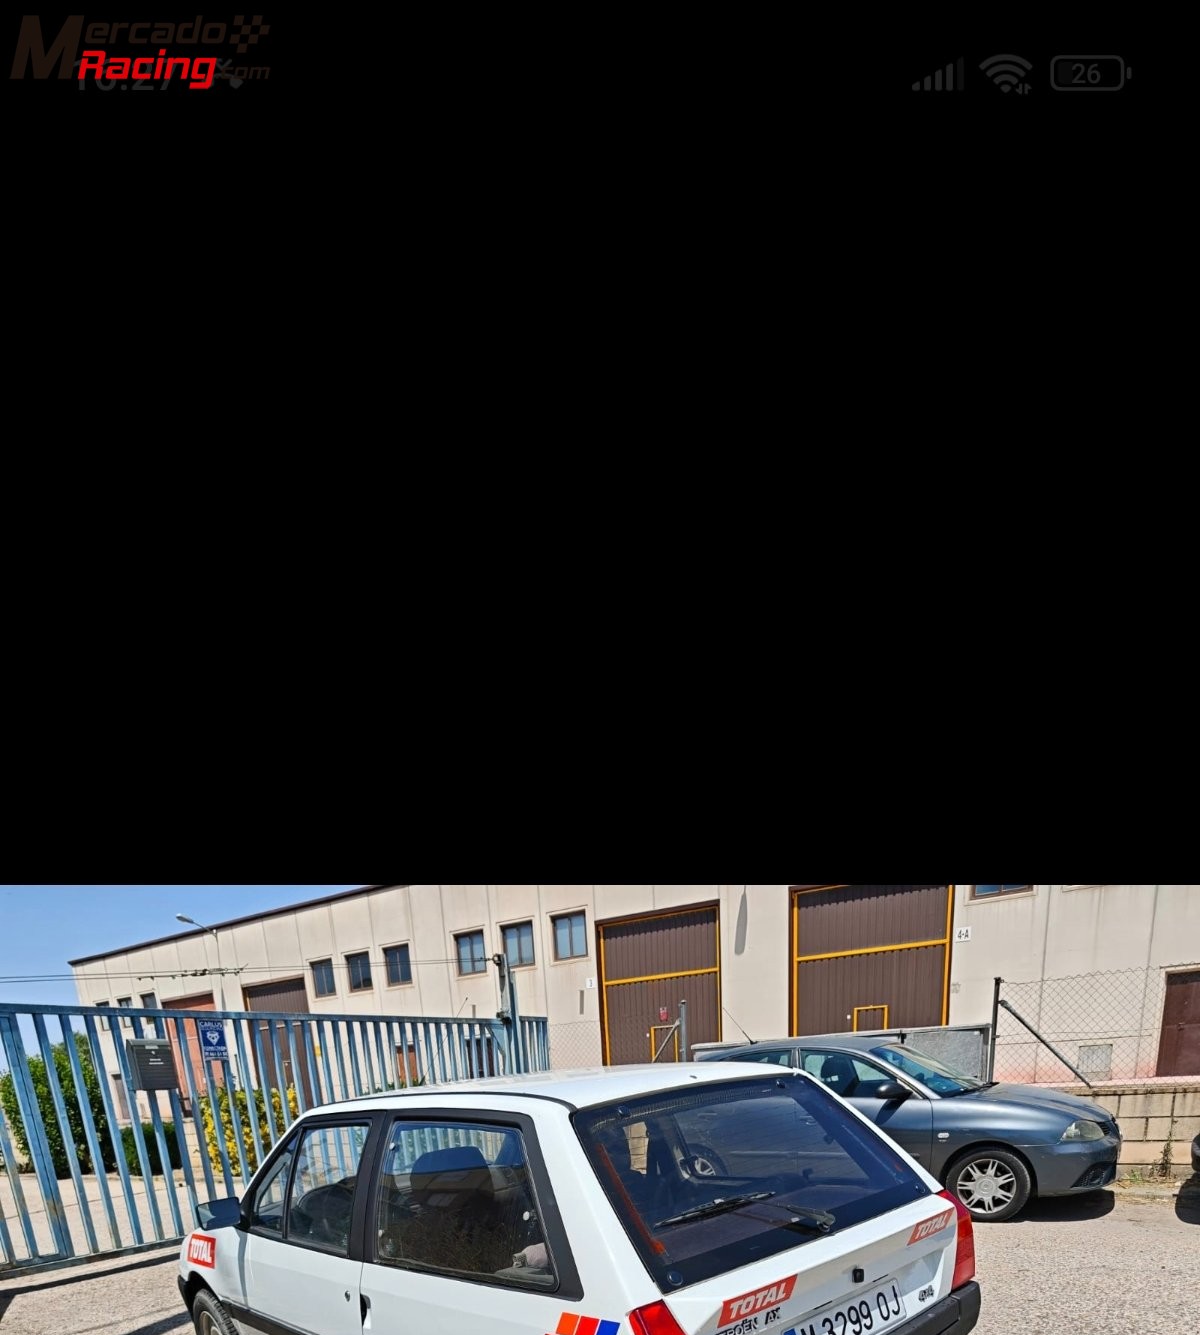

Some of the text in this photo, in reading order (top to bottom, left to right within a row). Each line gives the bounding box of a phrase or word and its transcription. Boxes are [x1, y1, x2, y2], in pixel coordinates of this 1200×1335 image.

[915, 1211, 949, 1240] TOTAL
[190, 1238, 212, 1263] TOTAL
[730, 1282, 787, 1319] TOTAL
[876, 1285, 900, 1321] OJ
